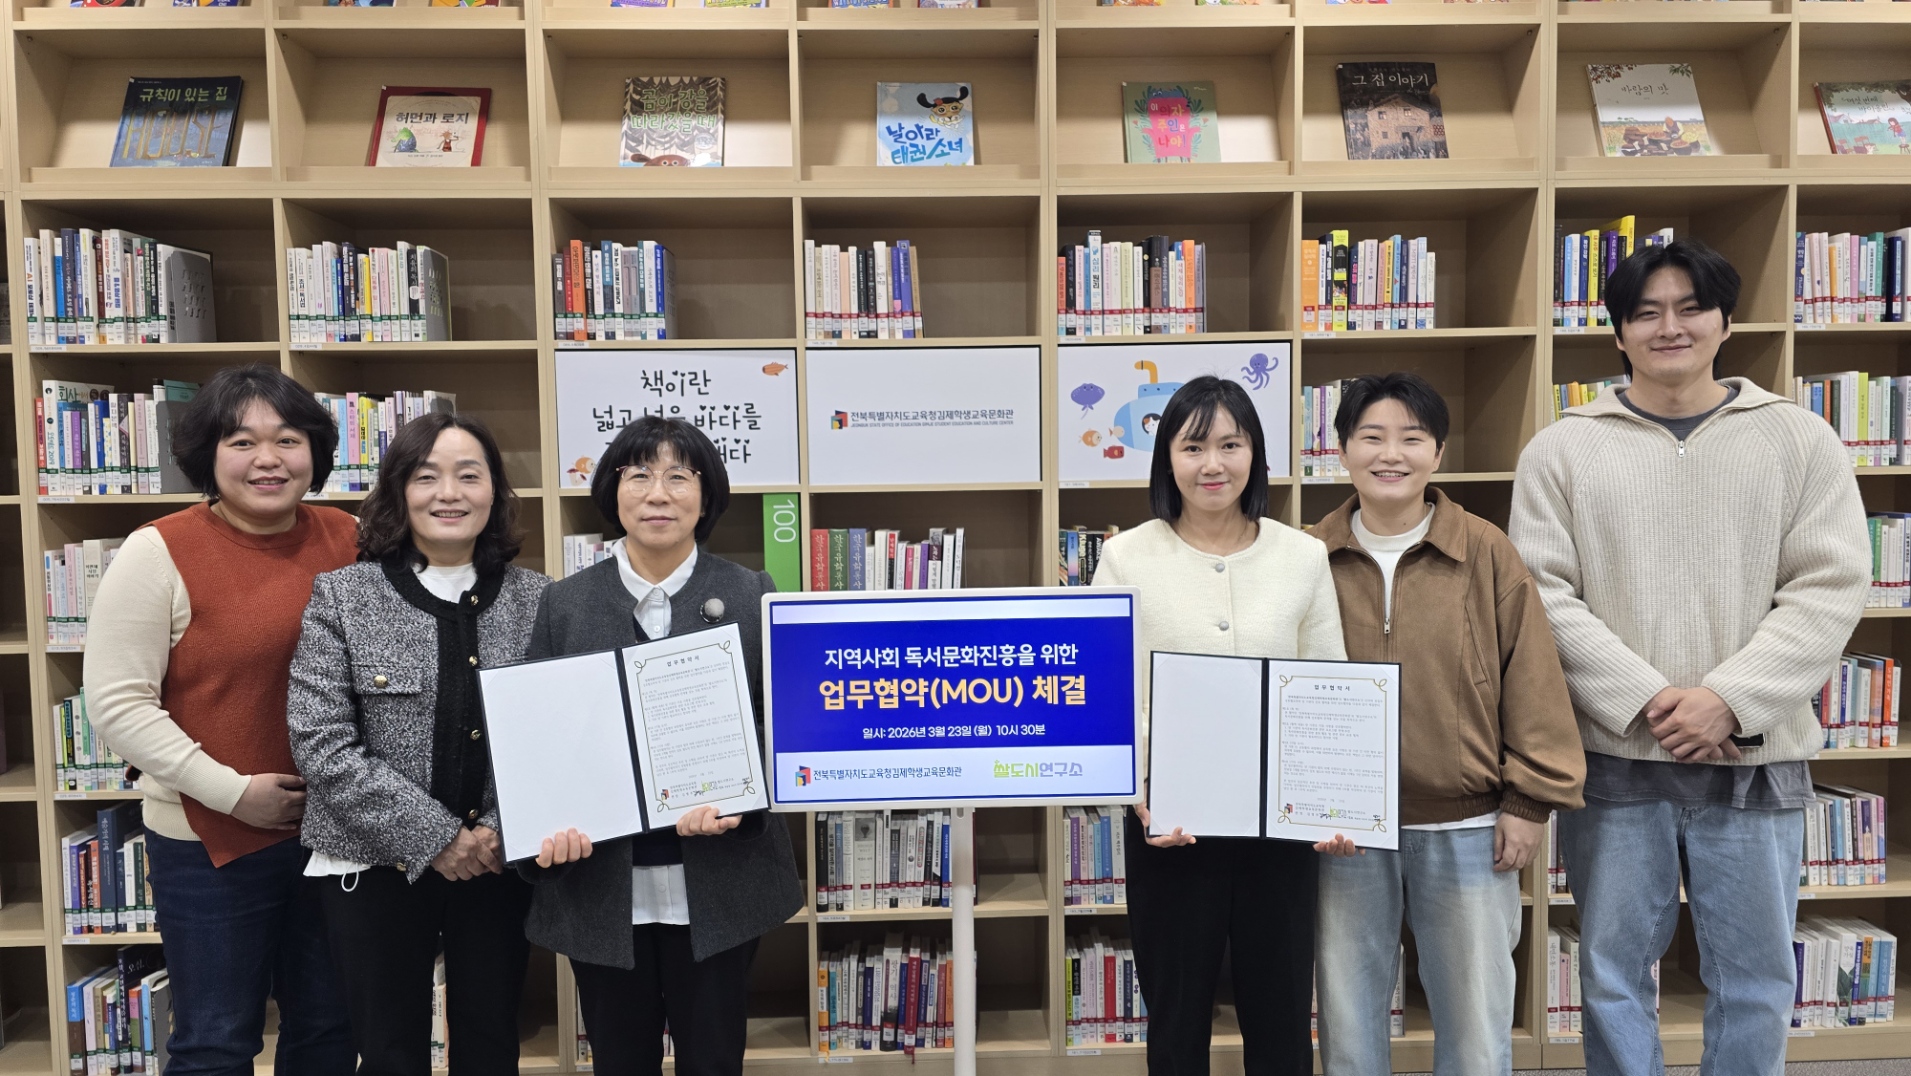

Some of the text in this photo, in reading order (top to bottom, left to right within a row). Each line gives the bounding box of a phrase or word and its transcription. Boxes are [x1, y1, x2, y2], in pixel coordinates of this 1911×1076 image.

[1352, 72, 1429, 88] 그 집 이야기
[140, 86, 228, 102] 규칙이 있는 집
[1621, 83, 1669, 96] 바람의 맛
[641, 88, 709, 113] 곰이 강을
[395, 112, 469, 124] 허먼과 로지
[696, 114, 717, 129] 때
[1157, 118, 1186, 133] 주인은
[885, 122, 941, 145] 날아라
[640, 369, 712, 398] 책이란
[592, 405, 633, 432] 넓고
[694, 403, 762, 430] 바다를
[850, 409, 1014, 422] 전북특별자치도교육청김제학생교육문화관
[773, 499, 796, 543] 100
[824, 644, 1078, 669] 지역사회 독서문화진흥을 위한
[819, 675, 1086, 710] 업무협약(MOU) 체결
[863, 724, 1046, 739] 일시: 2026년 3월 23일 (월) 10시 30분
[813, 766, 962, 780] 전북특별자치도교육청김제학생교육문화관
